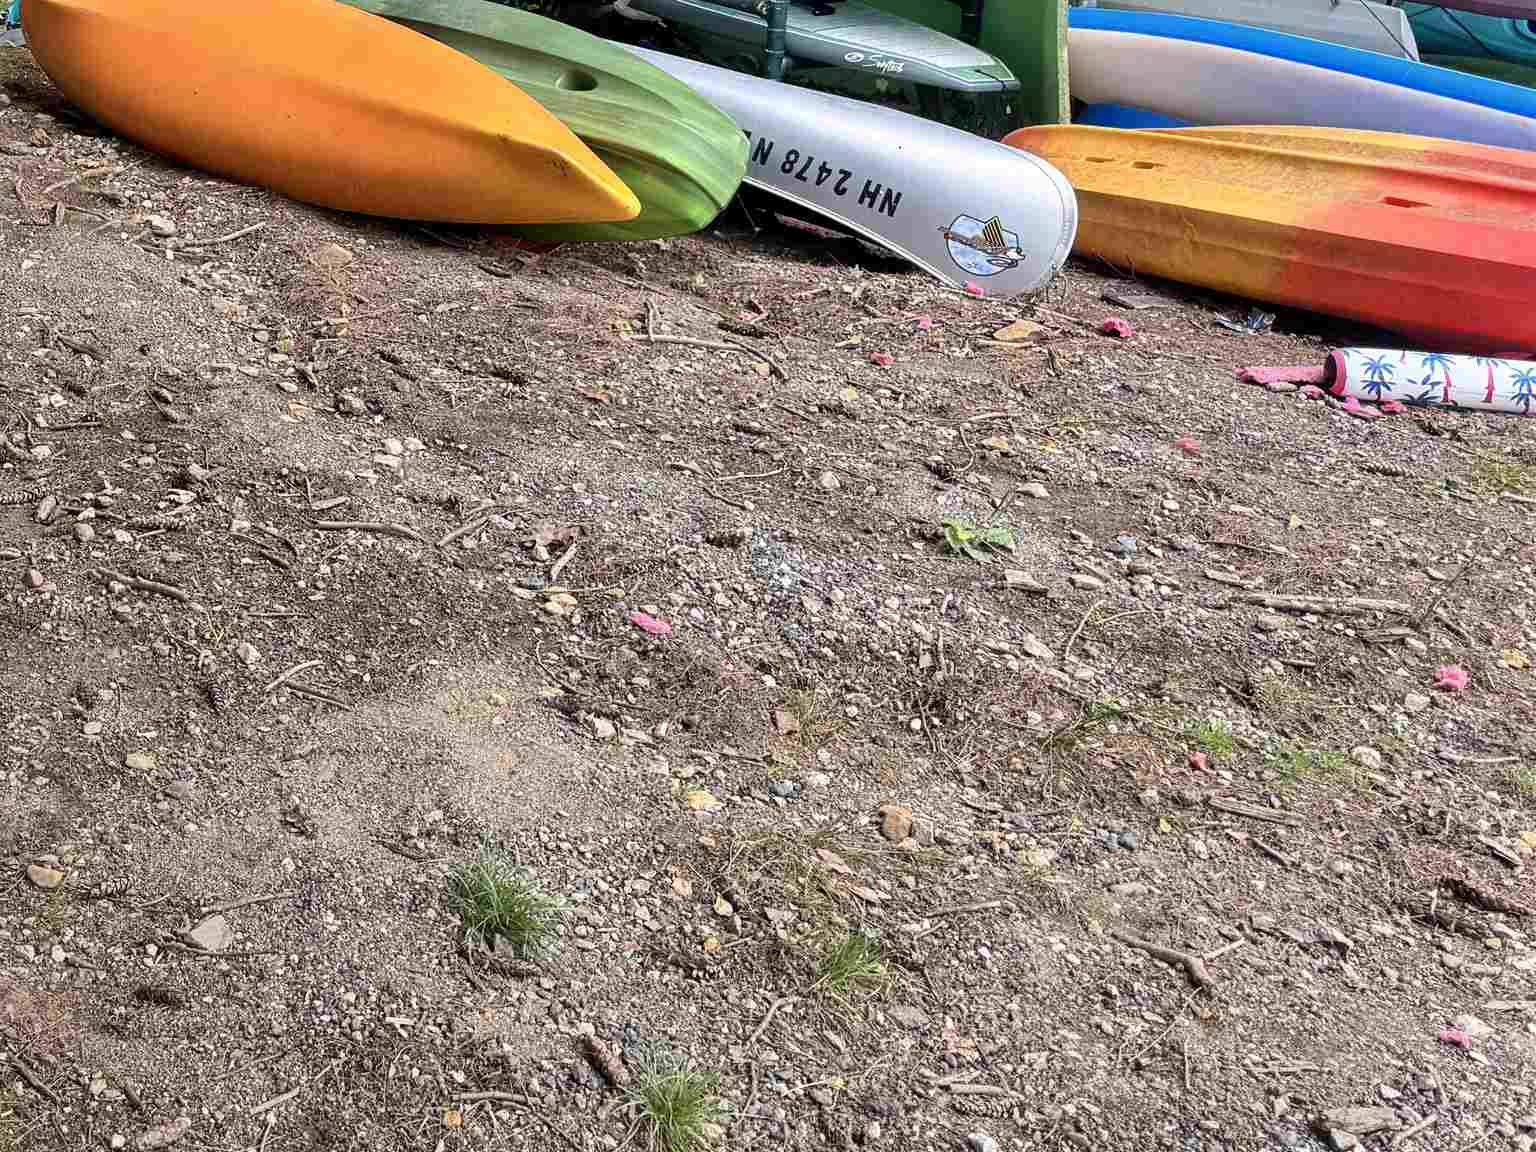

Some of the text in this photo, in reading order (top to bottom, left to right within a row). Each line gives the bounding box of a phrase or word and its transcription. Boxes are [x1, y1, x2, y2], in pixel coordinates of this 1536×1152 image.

[742, 129, 902, 217] NH 2478 N
